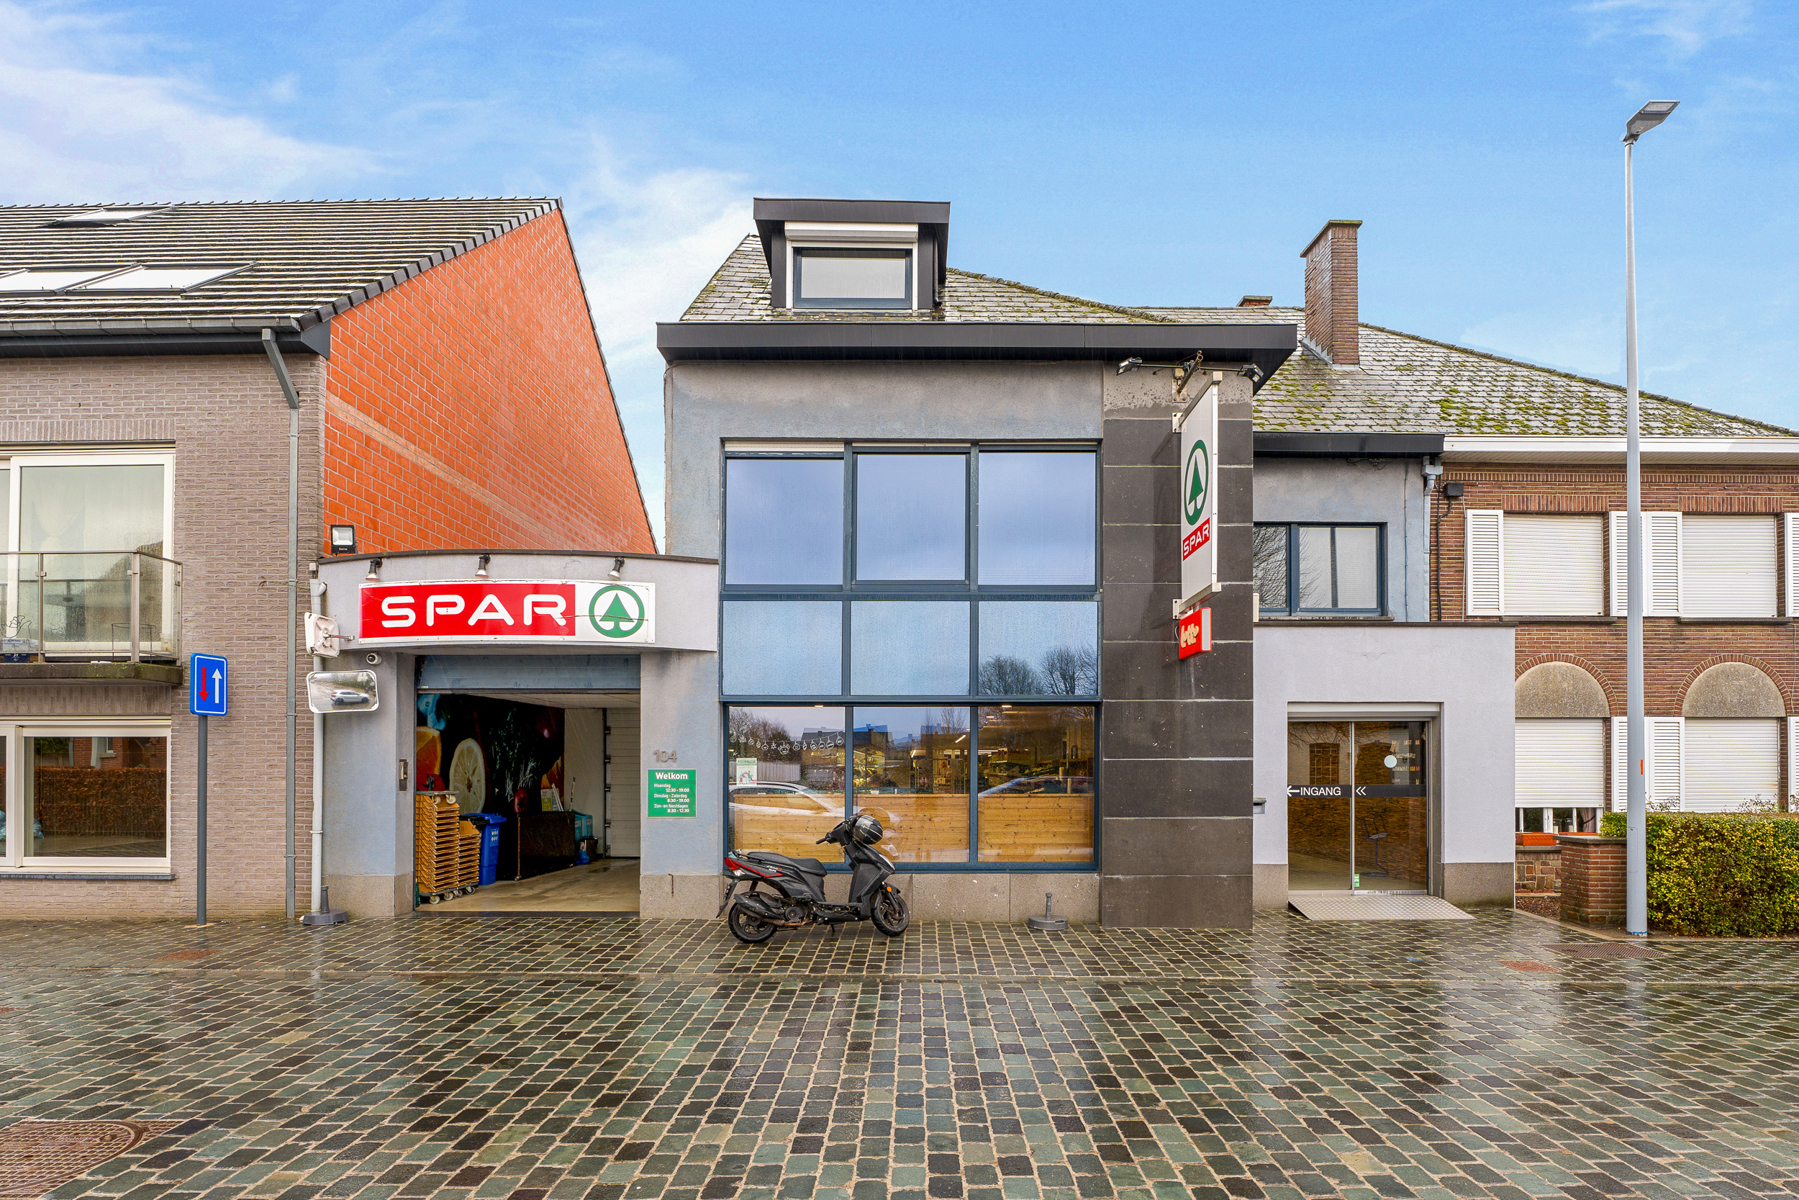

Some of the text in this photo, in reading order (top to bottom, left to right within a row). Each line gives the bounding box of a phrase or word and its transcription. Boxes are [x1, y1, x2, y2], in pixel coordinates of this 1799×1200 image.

[1183, 522, 1210, 557] SPAR
[381, 593, 568, 629] SPAR
[653, 749, 677, 763] 104
[655, 772, 688, 780] Welkom
[1300, 786, 1342, 796] INGANG
